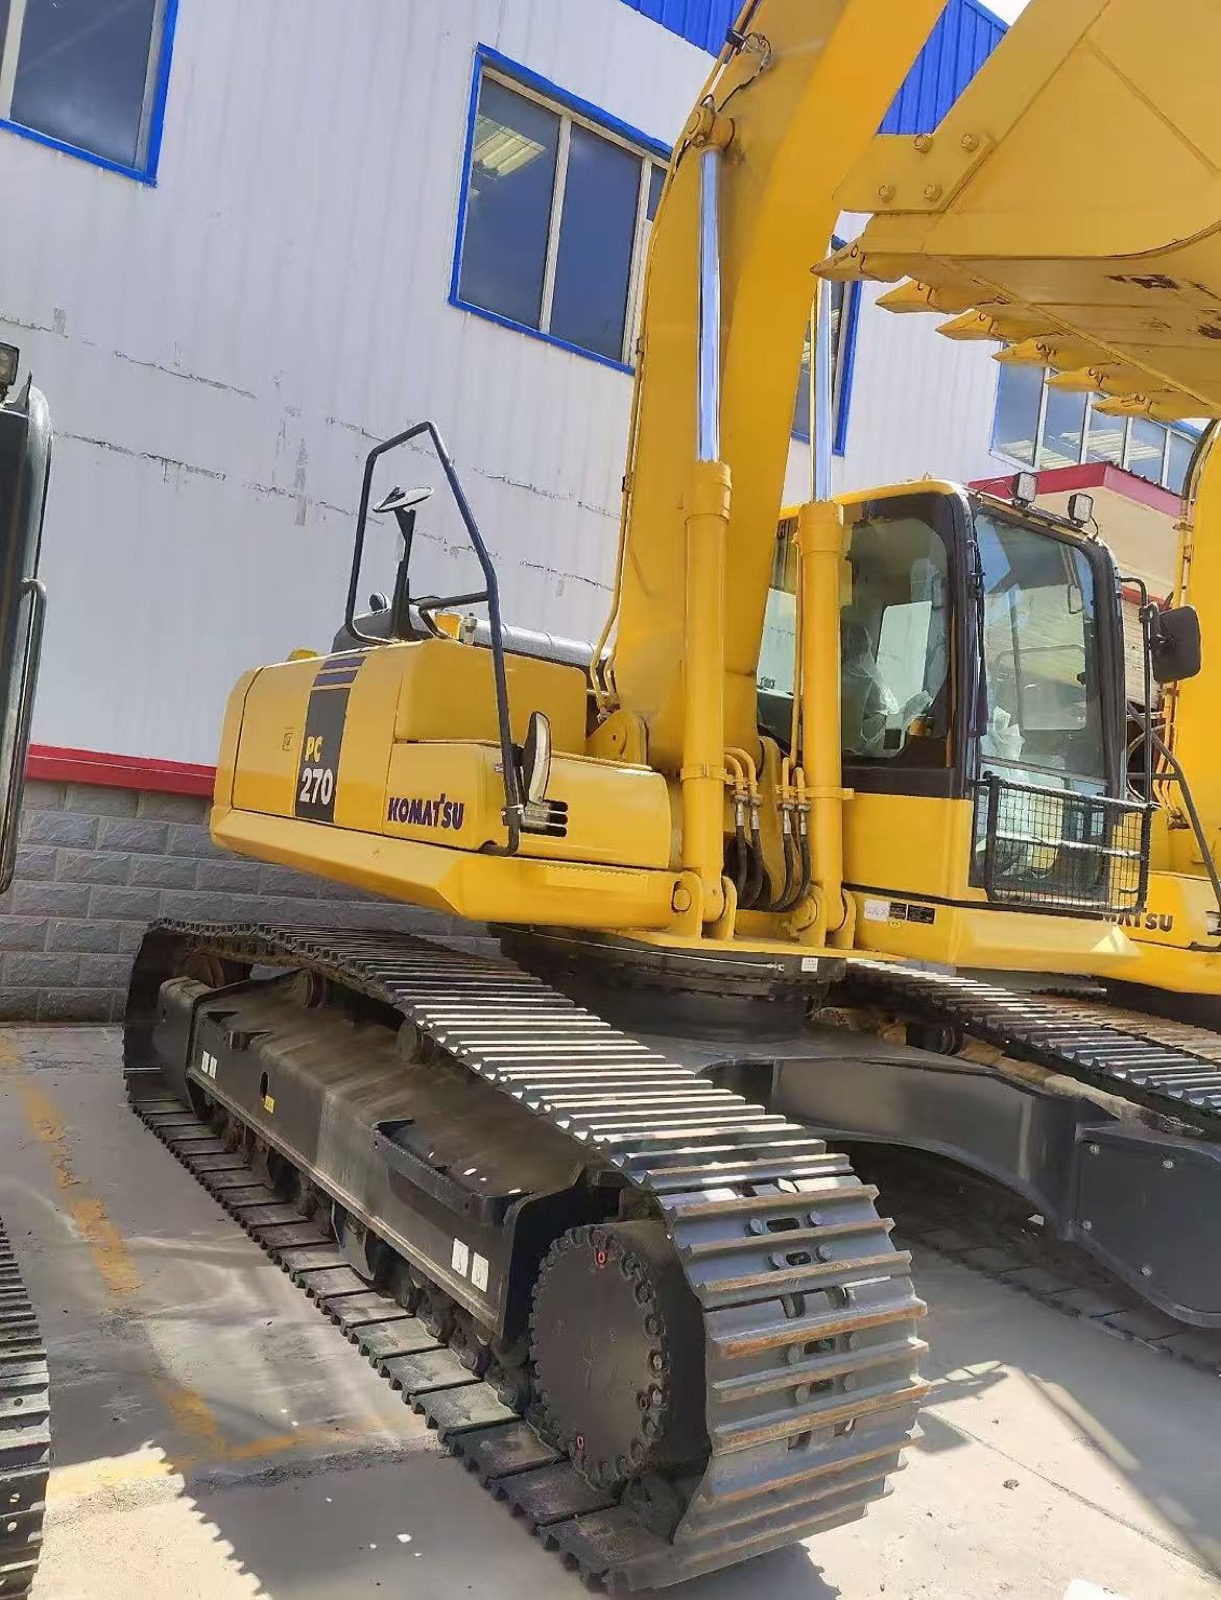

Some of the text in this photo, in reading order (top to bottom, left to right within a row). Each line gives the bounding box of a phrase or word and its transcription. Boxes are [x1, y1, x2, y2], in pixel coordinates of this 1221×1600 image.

[305, 736, 323, 763] PC
[299, 767, 334, 805] 270
[387, 793, 465, 830] KOMATSU
